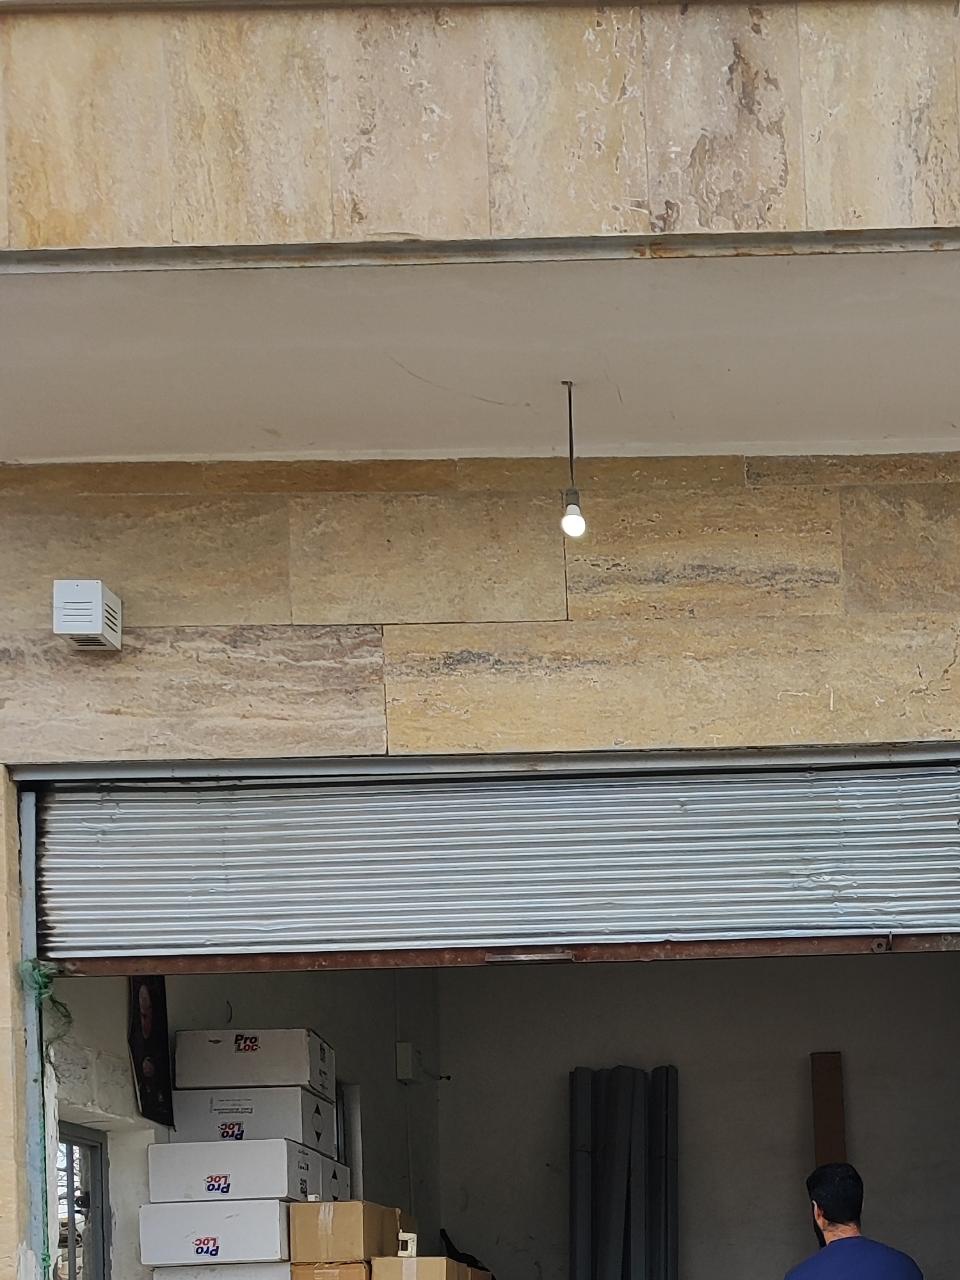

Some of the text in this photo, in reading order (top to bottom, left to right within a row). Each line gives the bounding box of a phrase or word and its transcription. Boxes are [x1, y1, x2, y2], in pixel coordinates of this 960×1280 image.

[234, 1034, 257, 1045] Pro
[221, 1130, 244, 1140] Pro
[207, 1183, 230, 1194] Pro
[195, 1246, 219, 1256] Pro
